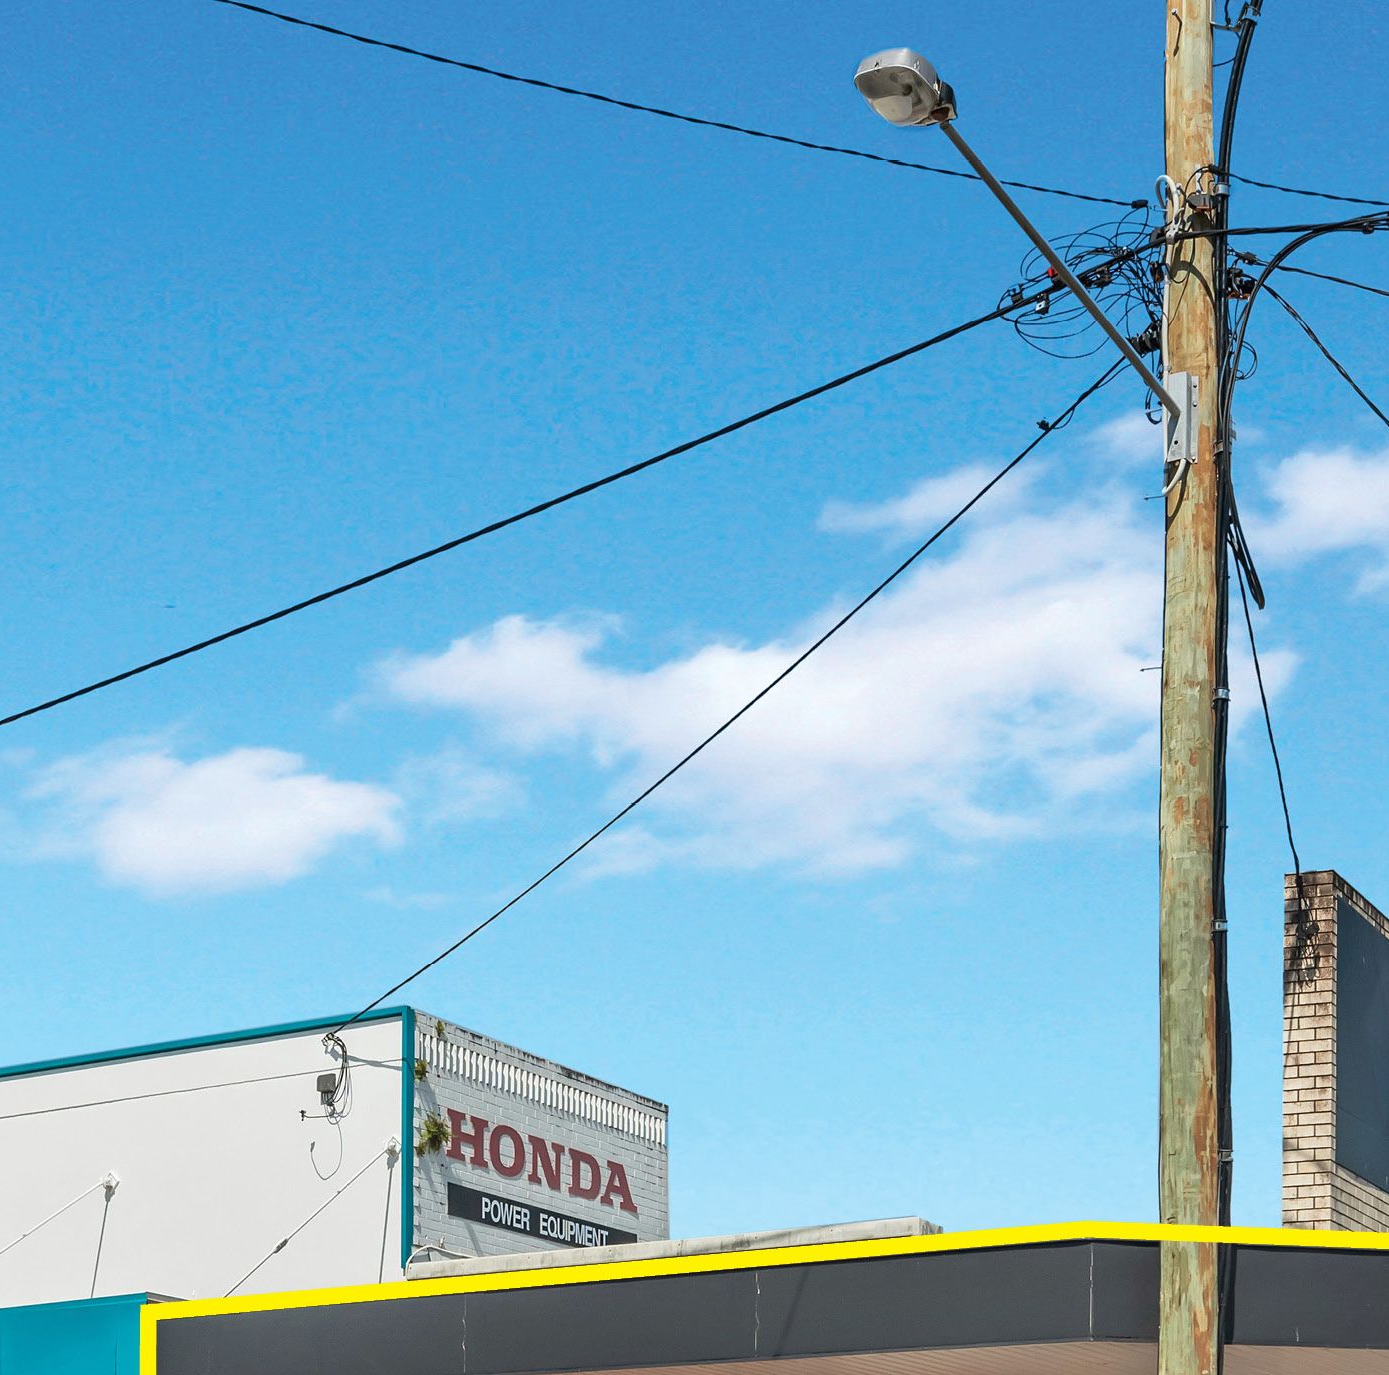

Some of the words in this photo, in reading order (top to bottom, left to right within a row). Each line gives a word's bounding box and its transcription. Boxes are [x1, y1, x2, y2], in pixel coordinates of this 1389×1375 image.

[446, 1108, 638, 1213] HONDA
[481, 1197, 530, 1231] POWER
[540, 1213, 609, 1246] EQUIPMENT
